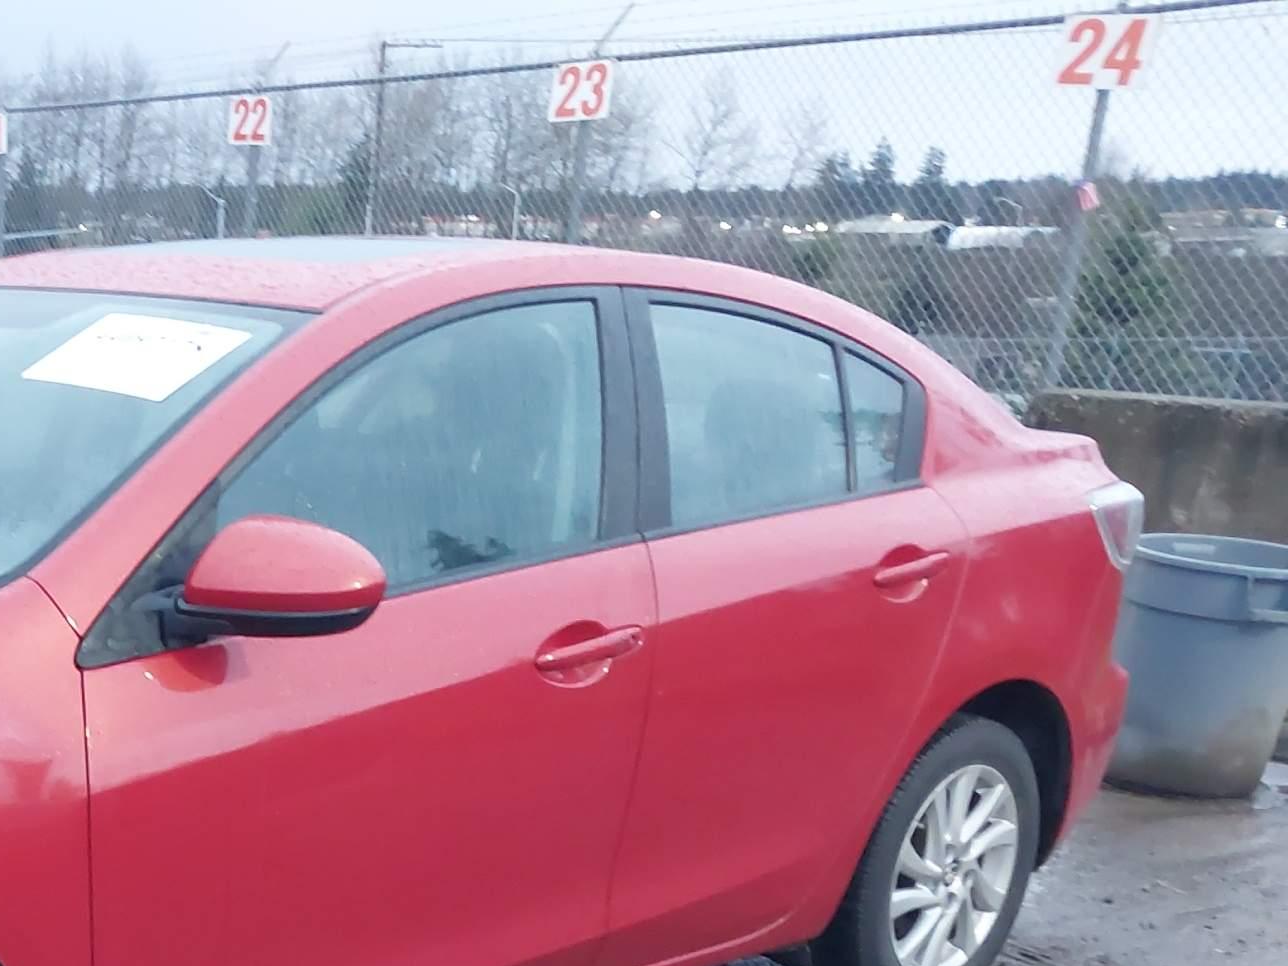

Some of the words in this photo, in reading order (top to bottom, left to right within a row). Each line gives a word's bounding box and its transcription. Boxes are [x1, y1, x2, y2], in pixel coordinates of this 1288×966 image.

[1057, 17, 1148, 86] 24
[555, 63, 607, 118] 23
[233, 98, 267, 141] 22
